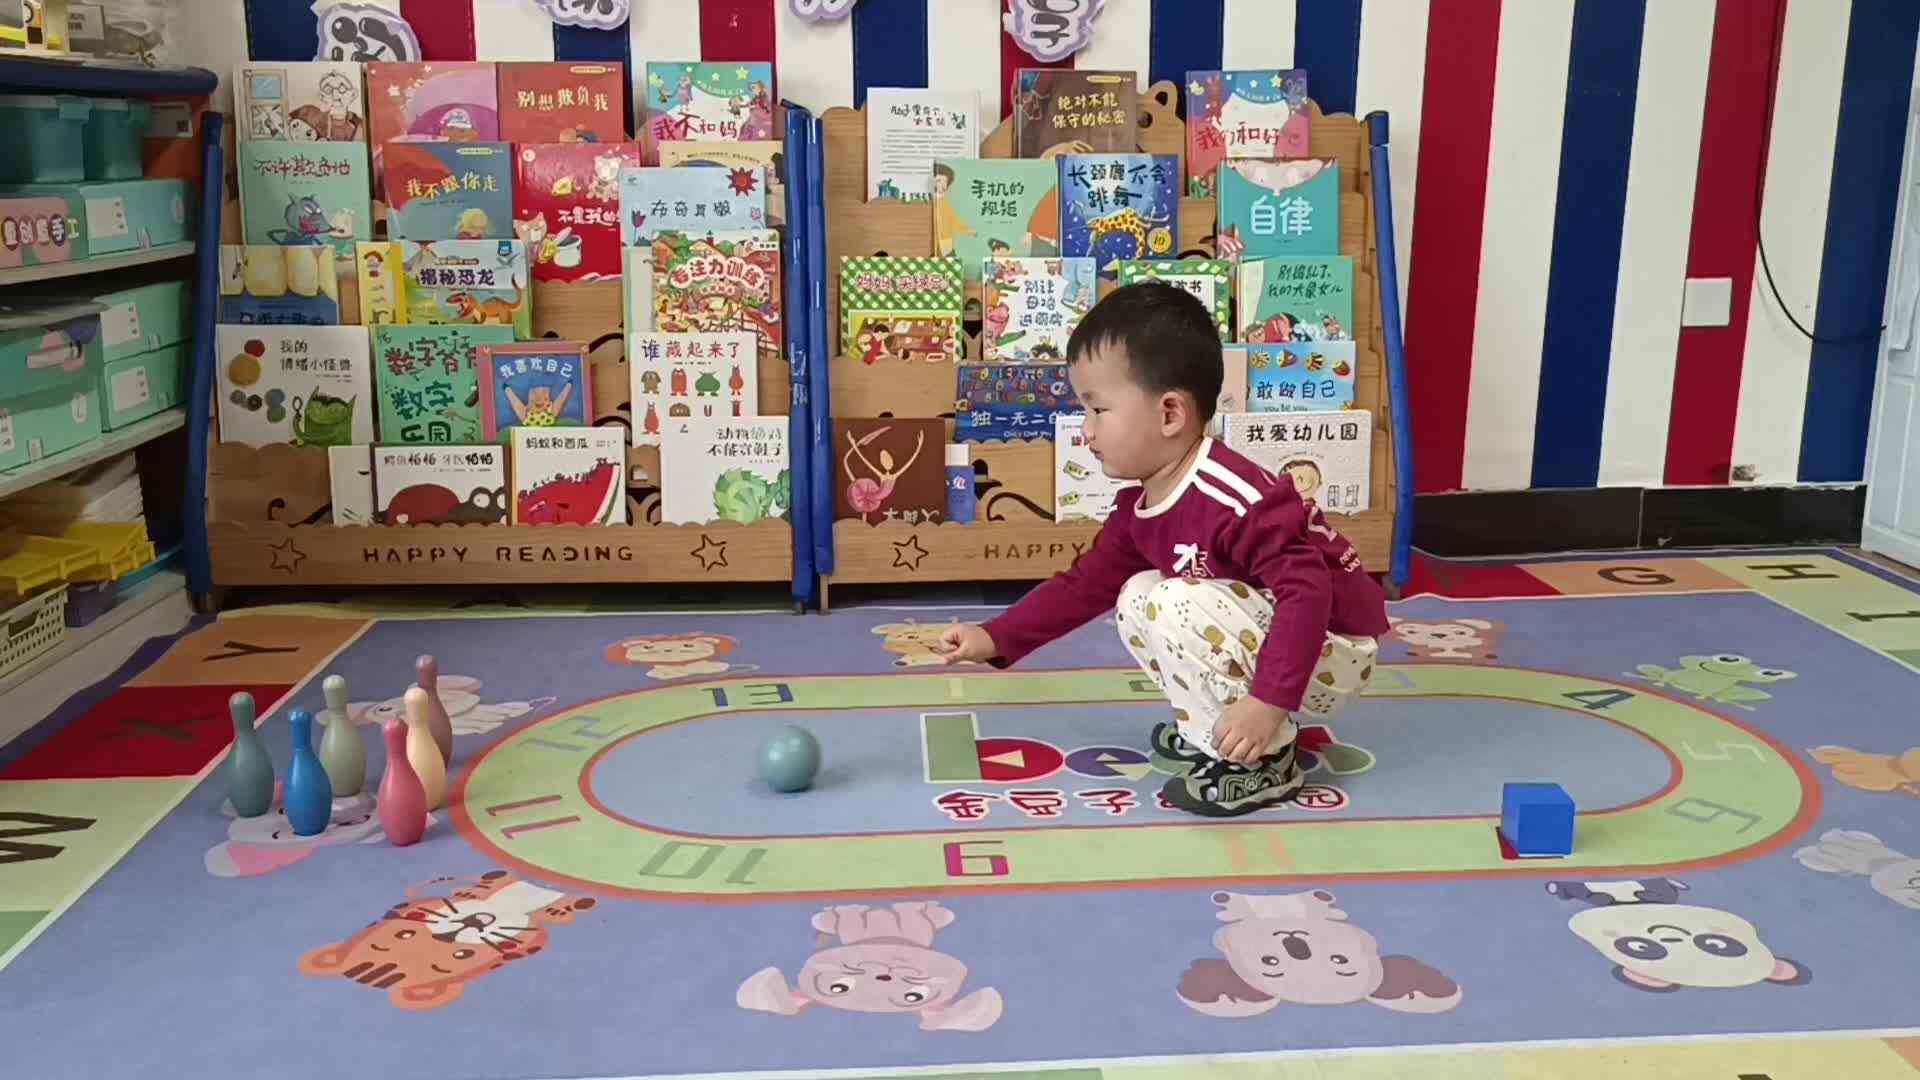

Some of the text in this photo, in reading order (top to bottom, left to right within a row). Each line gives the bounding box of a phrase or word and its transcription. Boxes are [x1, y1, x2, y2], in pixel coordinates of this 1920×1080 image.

[1057, 92, 1118, 111] 绝对不能
[1068, 160, 1167, 189] 长颈鹿不会
[971, 179, 1025, 198] 手机的
[980, 200, 1018, 217] 规矩
[1087, 187, 1143, 213] 跳舞
[1250, 196, 1313, 235] 自律
[419, 267, 495, 287] 揭秘恐龙
[280, 339, 308, 354] 我的
[641, 338, 741, 359] 谁藏起来了
[500, 356, 573, 379] 我喜欢自己
[1246, 379, 1336, 400] 敢做自己
[971, 409, 1085, 427] 独一无二的
[526, 436, 589, 450] 蚂蚁和西瓜
[363, 545, 634, 563] HAPPY READING
[984, 541, 1087, 560] HAPPY
[936, 785, 1344, 819] 金豆子园
